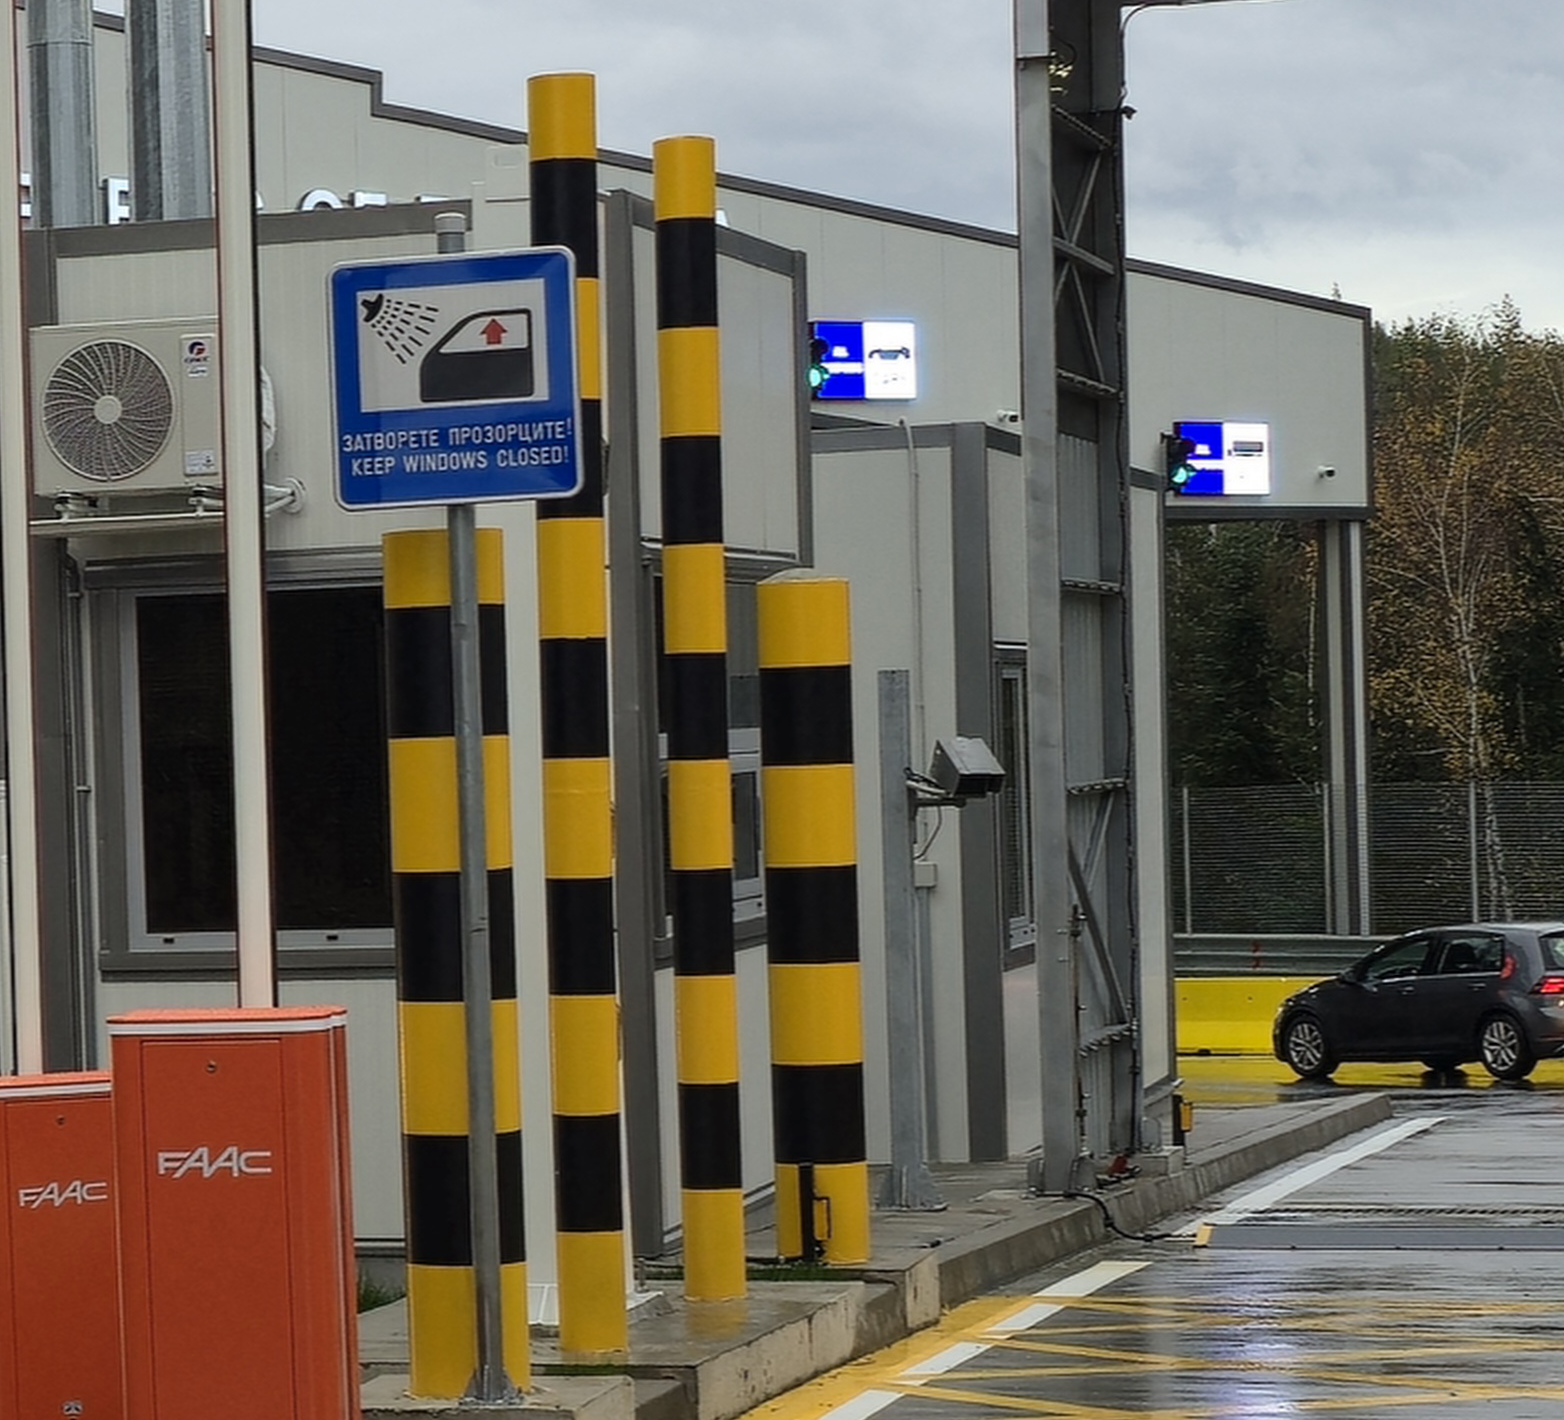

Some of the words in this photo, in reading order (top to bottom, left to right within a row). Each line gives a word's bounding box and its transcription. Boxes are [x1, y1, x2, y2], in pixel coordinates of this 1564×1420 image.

[342, 429, 440, 452] ЗАТВОРЕТЕ
[448, 417, 573, 446] ПРОЗОРЦИТЕ!
[351, 456, 396, 477] KEEP
[402, 450, 489, 473] WINDOWS
[496, 445, 570, 468] CLOSED!
[157, 1146, 272, 1177] FAAC
[18, 1181, 108, 1209] FAAC
